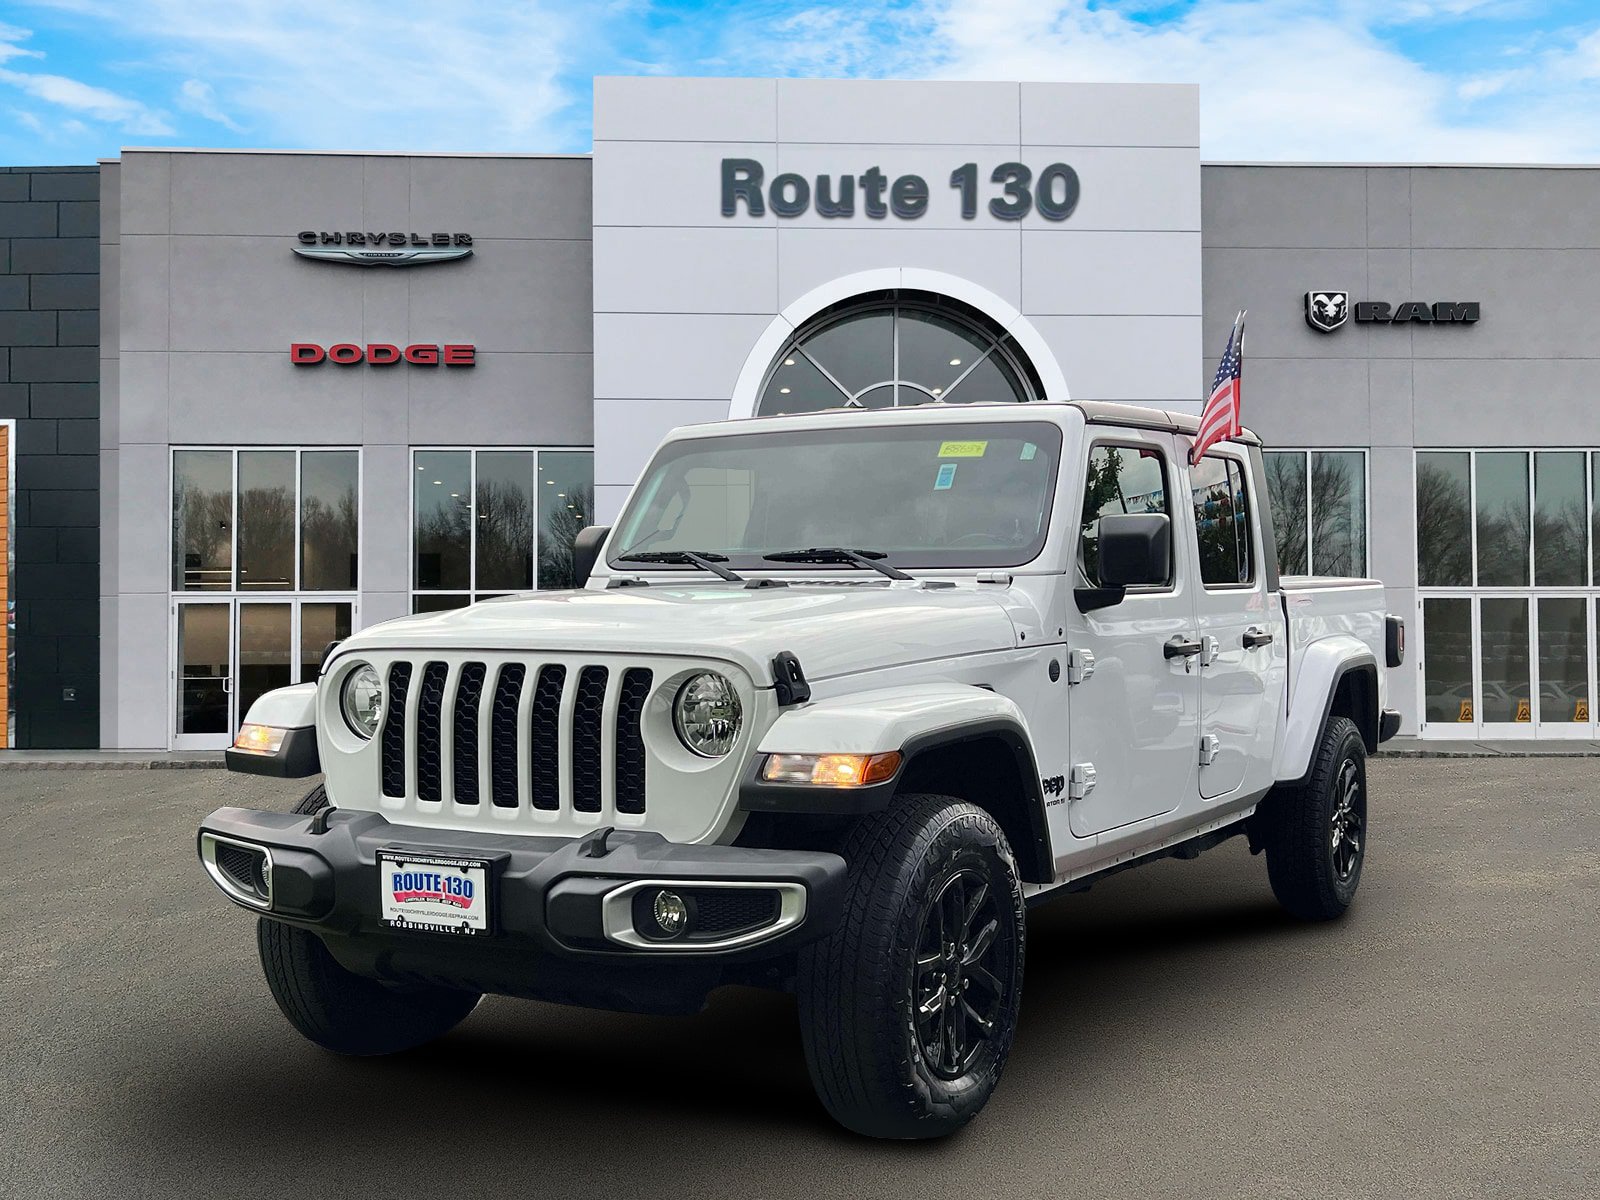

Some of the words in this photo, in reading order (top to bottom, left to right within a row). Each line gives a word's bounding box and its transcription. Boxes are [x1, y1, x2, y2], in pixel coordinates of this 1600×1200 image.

[721, 158, 929, 219] Route
[950, 162, 1080, 221] 130
[297, 231, 473, 246] CHRYSLER
[1355, 301, 1480, 325] RAM
[291, 343, 476, 365] DODGE
[1042, 775, 1065, 797] eep
[392, 872, 441, 892] ROUTE
[444, 876, 473, 898] 130
[390, 921, 460, 934] ROBBINSVILLE,
